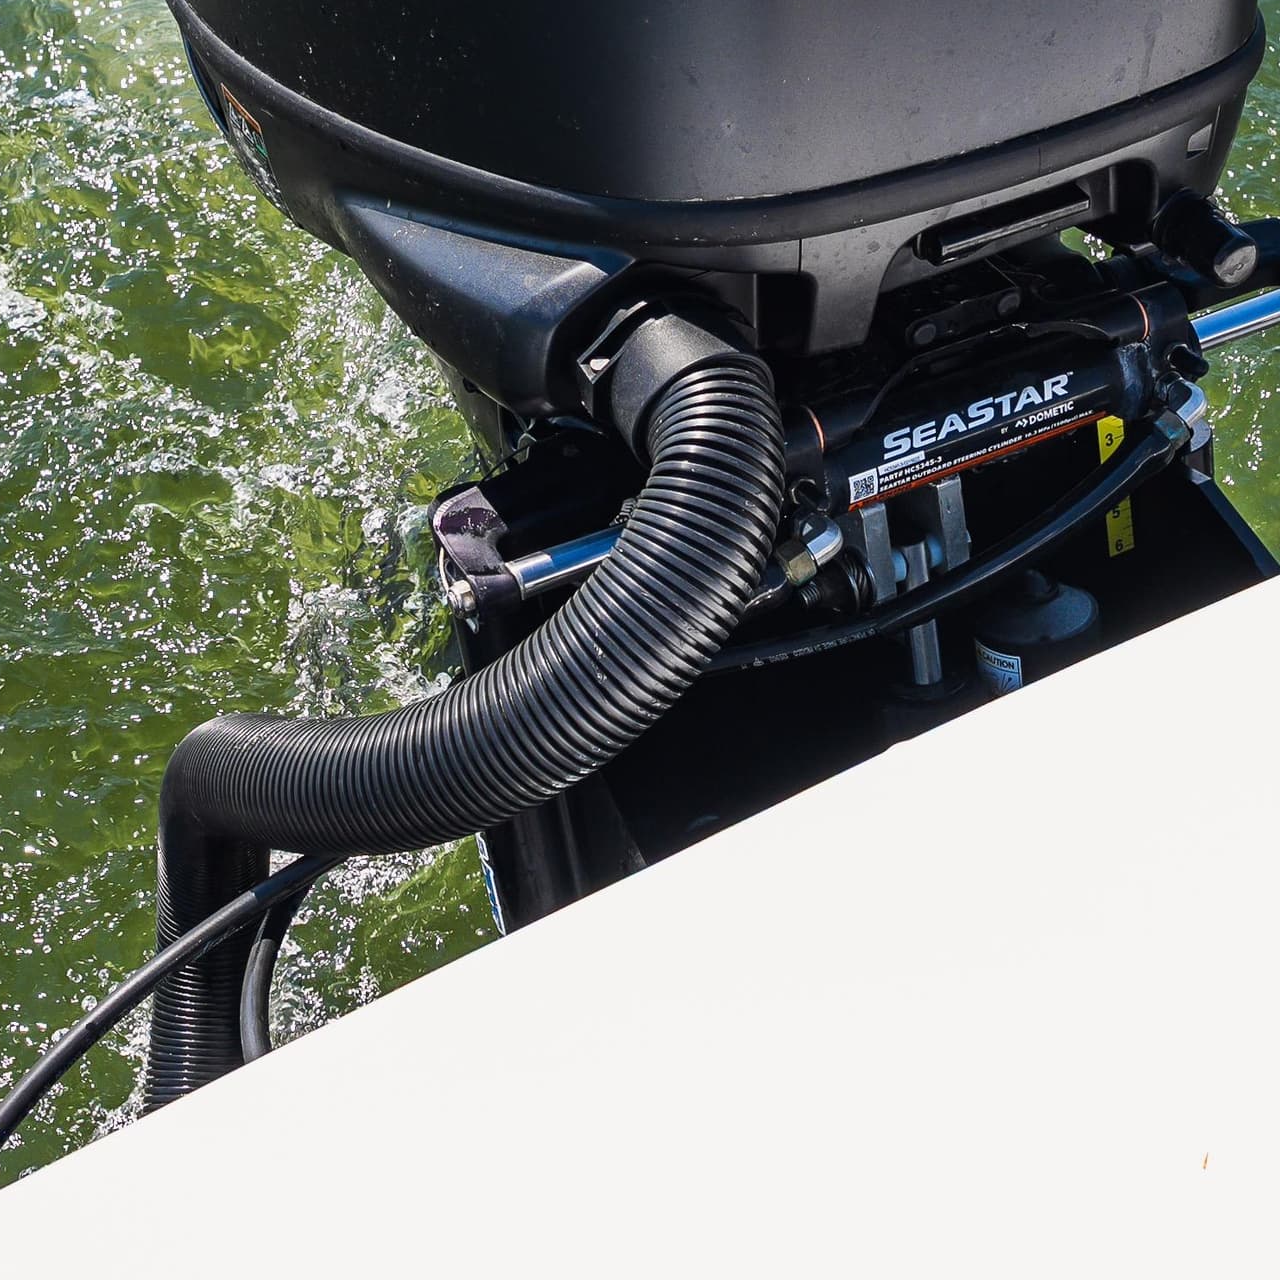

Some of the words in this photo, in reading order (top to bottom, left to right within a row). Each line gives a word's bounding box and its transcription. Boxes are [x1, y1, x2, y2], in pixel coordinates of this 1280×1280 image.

[1029, 400, 1075, 426] DOMETIC
[1104, 432, 1114, 448] 3
[879, 475, 911, 493] SEASTAR
[911, 460, 953, 480] OUTBOARD
[953, 447, 988, 468] STEERING
[988, 435, 1023, 452] CYLINDER
[879, 470, 904, 486] PART#
[1115, 538, 1124, 552] 6
[982, 650, 1015, 670] CAUTION
